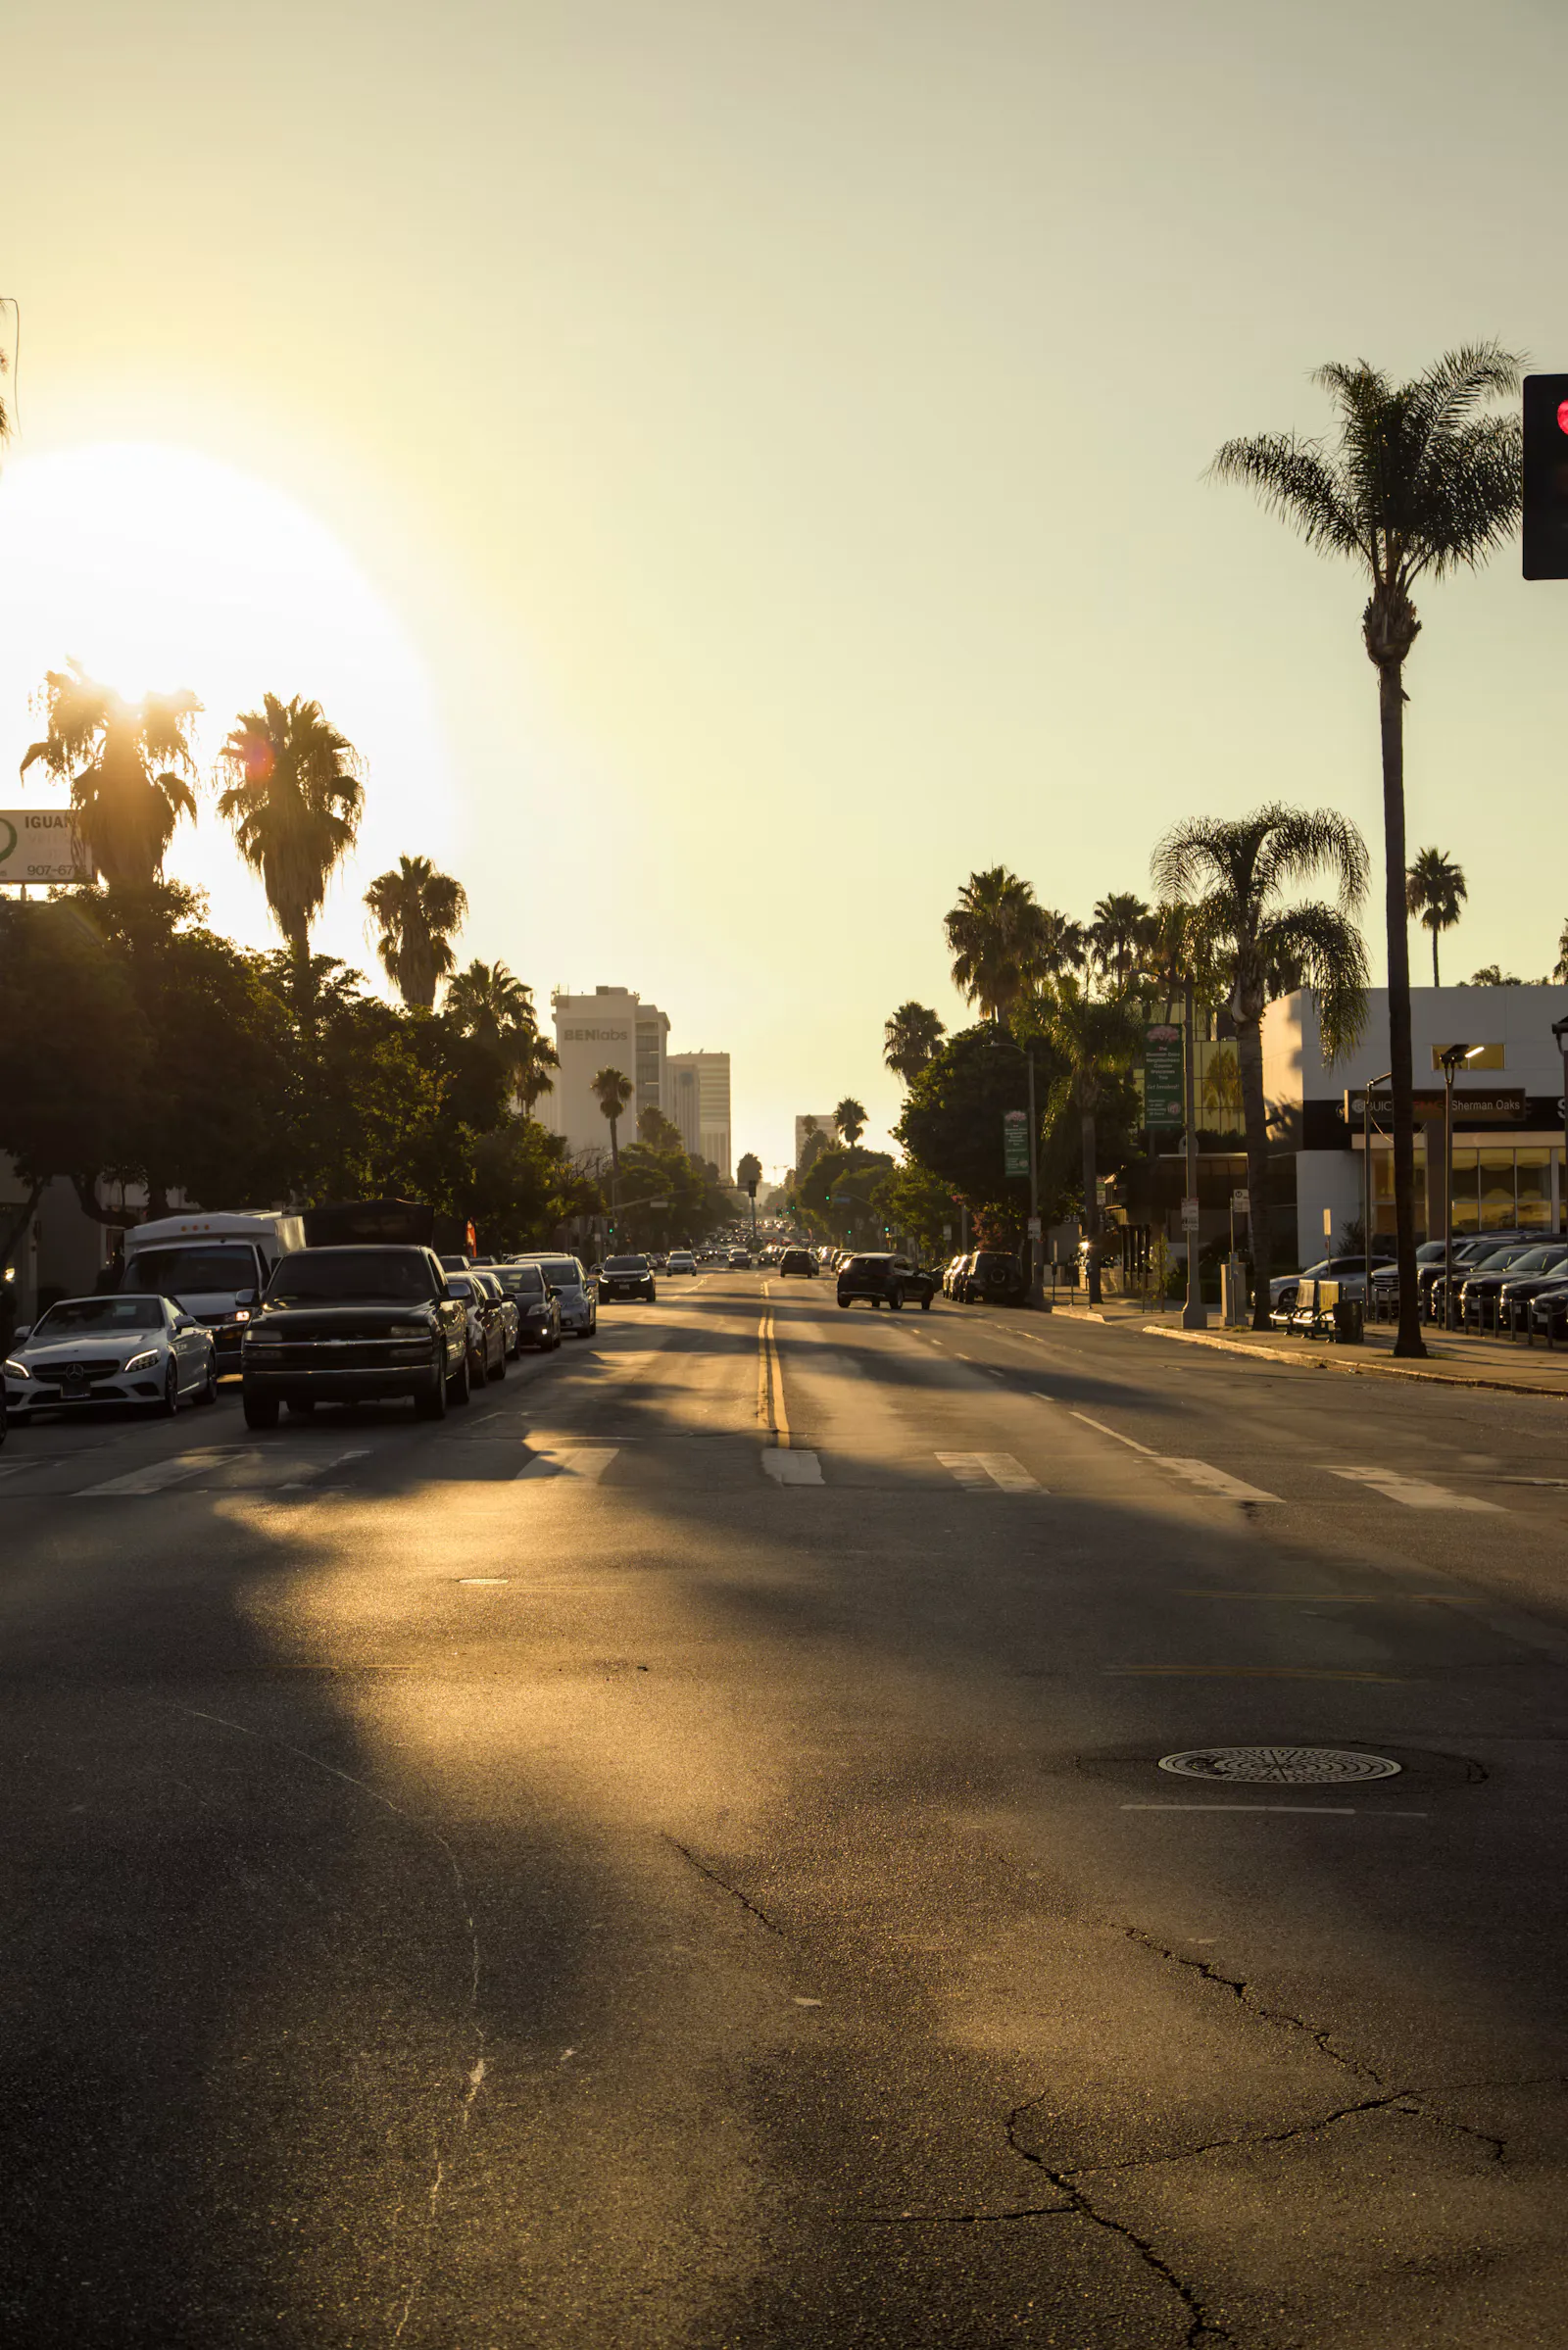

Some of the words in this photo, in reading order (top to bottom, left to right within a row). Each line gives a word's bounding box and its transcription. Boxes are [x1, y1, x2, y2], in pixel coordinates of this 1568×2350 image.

[26, 864, 78, 877] 907-67
[564, 1028, 628, 1041] BENlabs
[1366, 1101, 1393, 1112] BUIC
[1451, 1100, 1494, 1110] Sherman
[1495, 1099, 1520, 1110] Oaks
